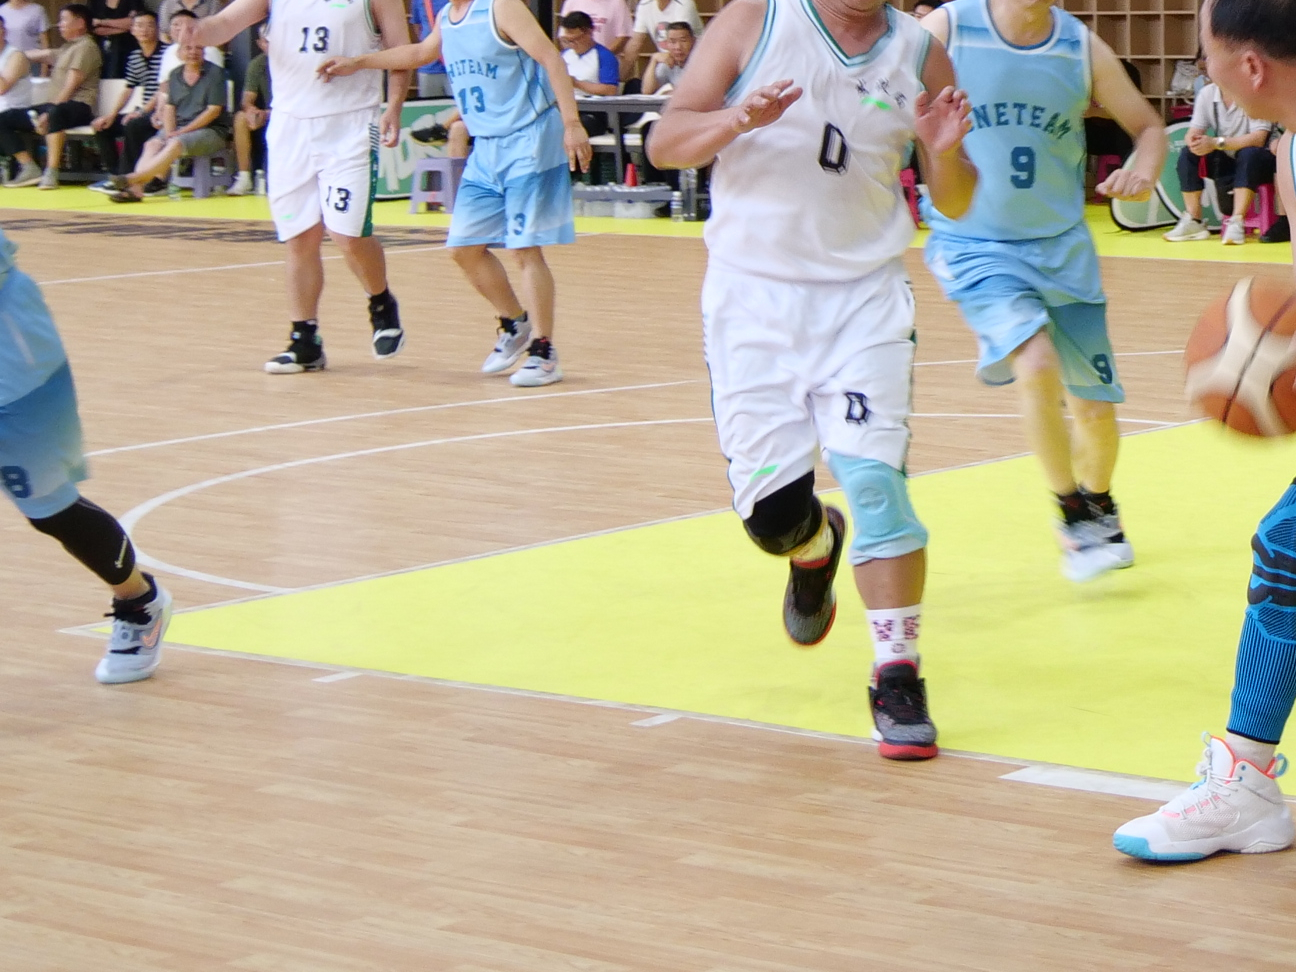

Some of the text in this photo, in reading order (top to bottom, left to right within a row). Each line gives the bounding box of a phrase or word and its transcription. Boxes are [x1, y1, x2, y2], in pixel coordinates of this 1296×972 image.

[299, 26, 330, 54] 13
[458, 86, 486, 115] 13
[1010, 146, 1037, 190] 9
[325, 185, 353, 214] 13
[1091, 353, 1114, 385] 9
